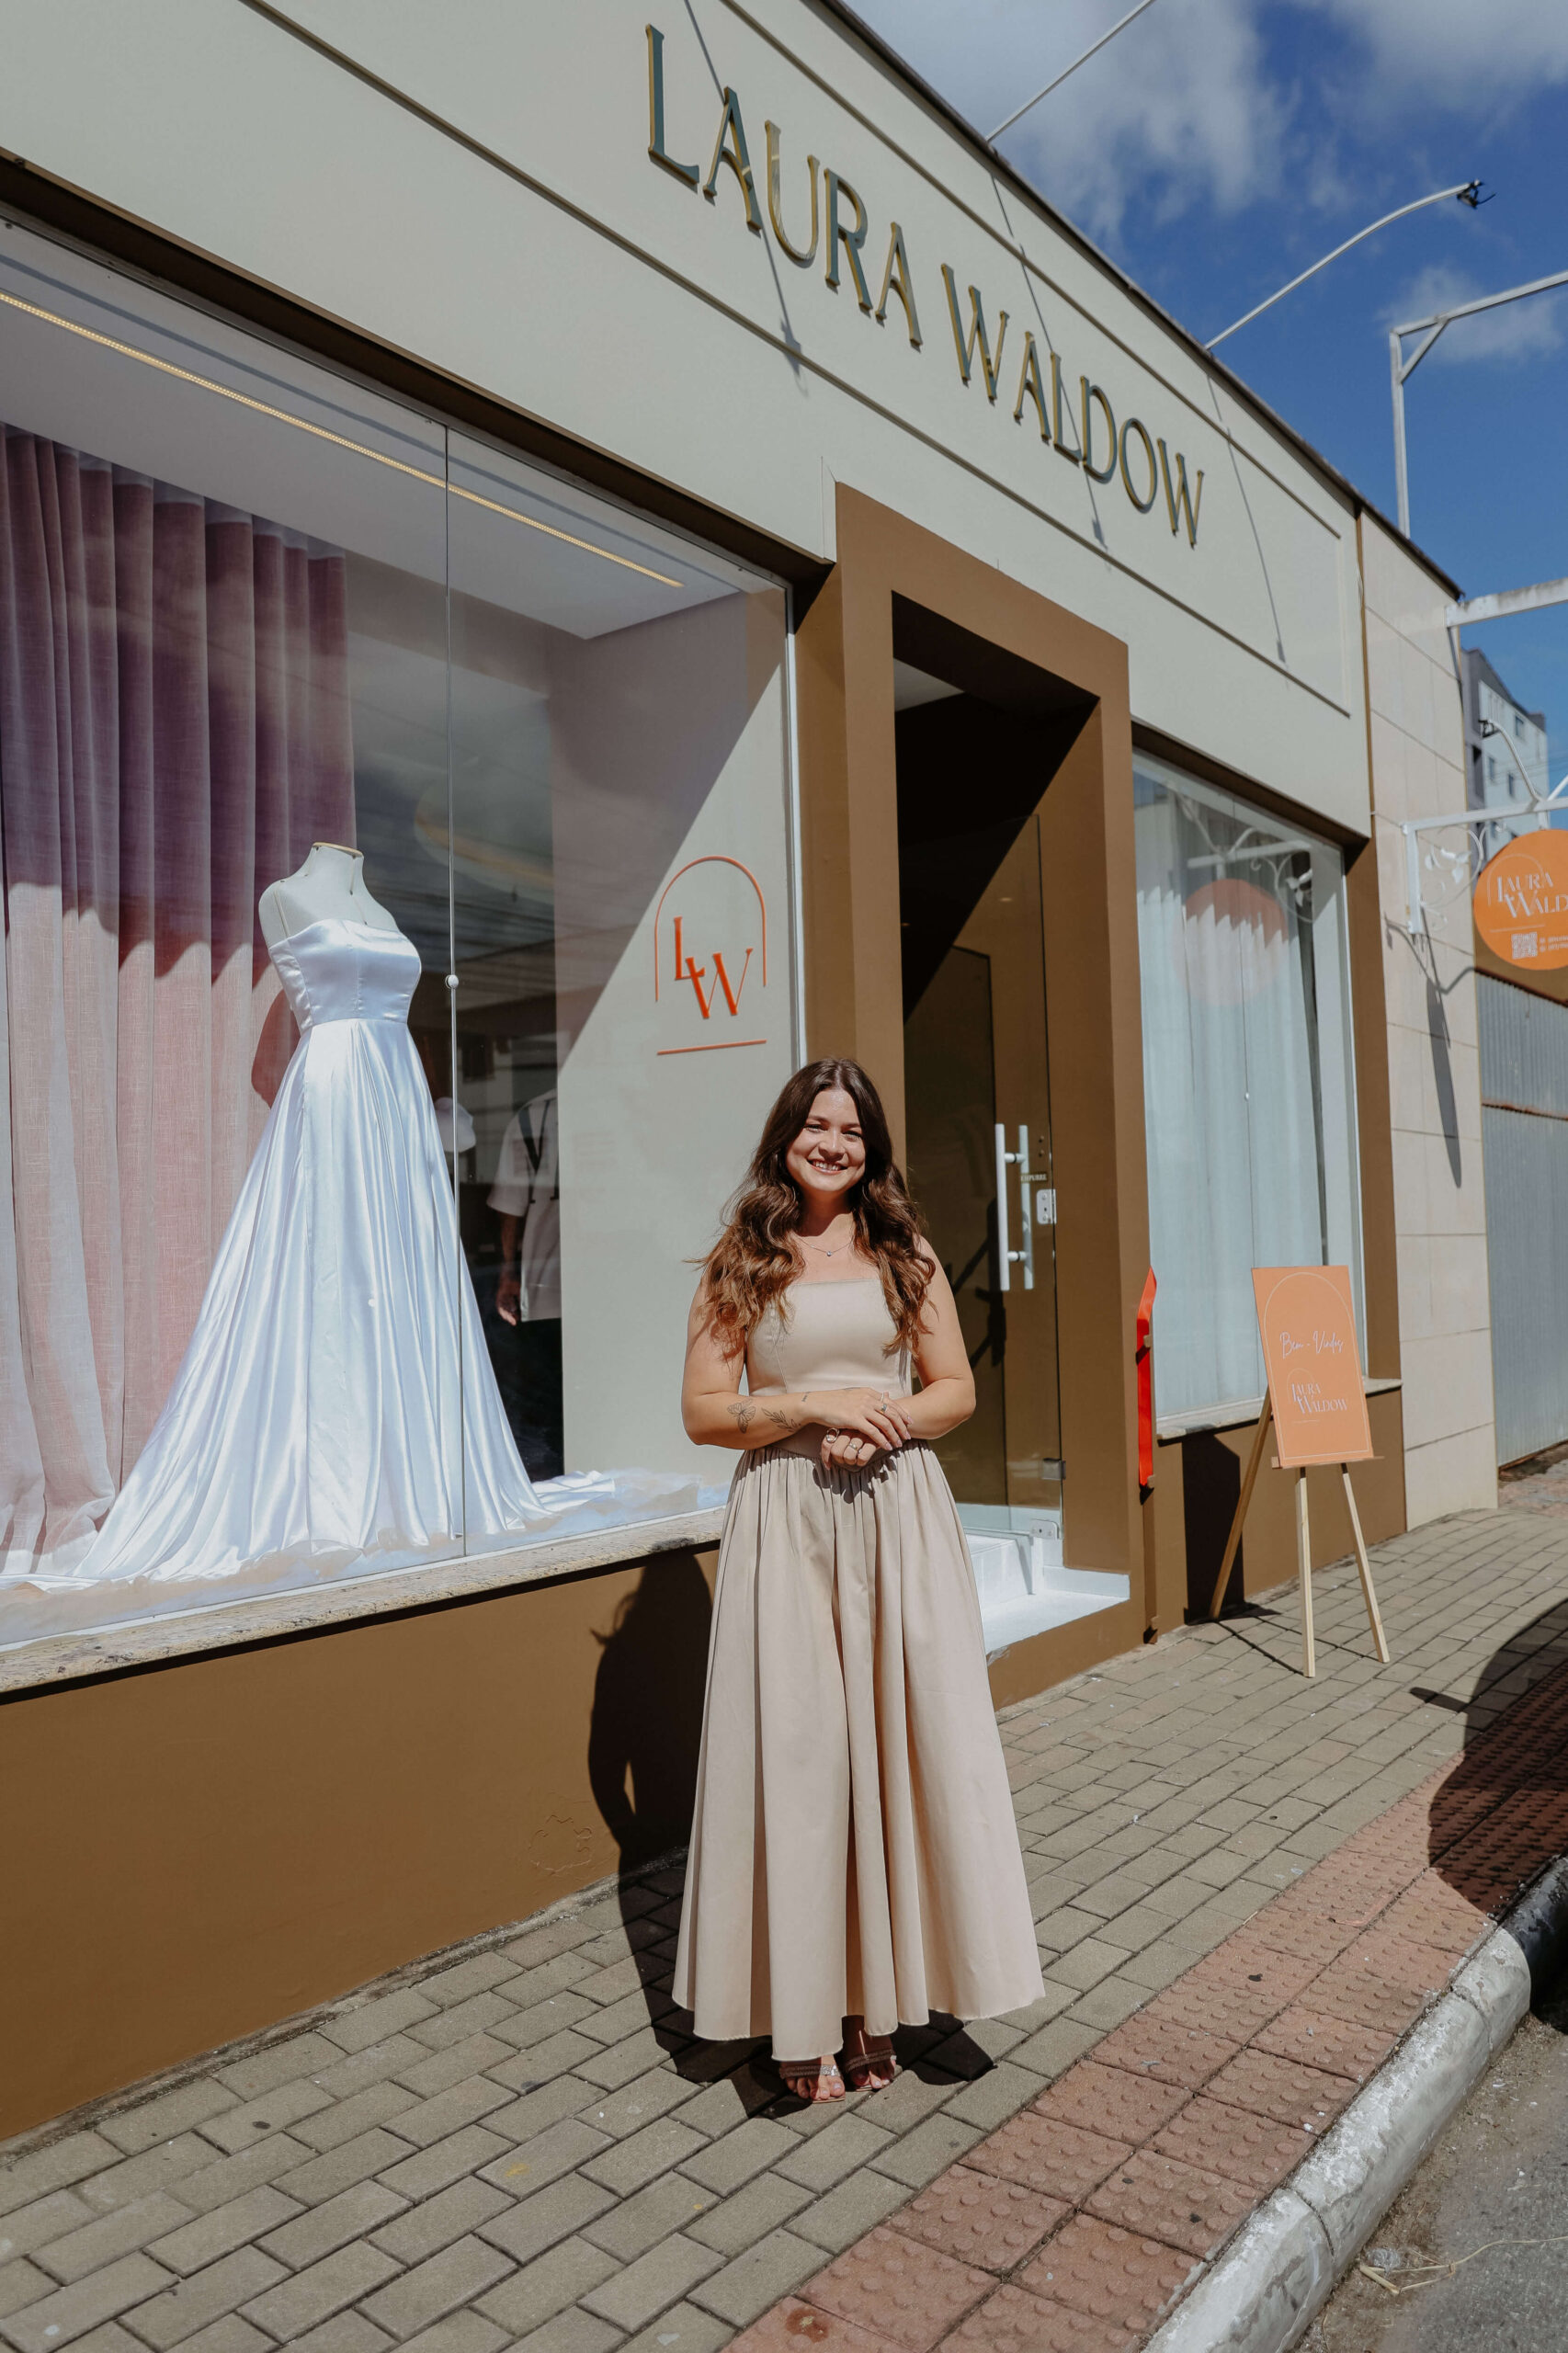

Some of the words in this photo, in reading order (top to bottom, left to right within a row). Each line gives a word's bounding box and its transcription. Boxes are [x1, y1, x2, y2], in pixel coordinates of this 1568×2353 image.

[645, 24, 923, 351] LAURA
[940, 263, 1205, 549] WALDOW
[1497, 872, 1553, 903] LAURA
[673, 916, 754, 1019] LW
[1291, 1383, 1322, 1402] LAURA
[1296, 1395, 1347, 1414] WALDOW
